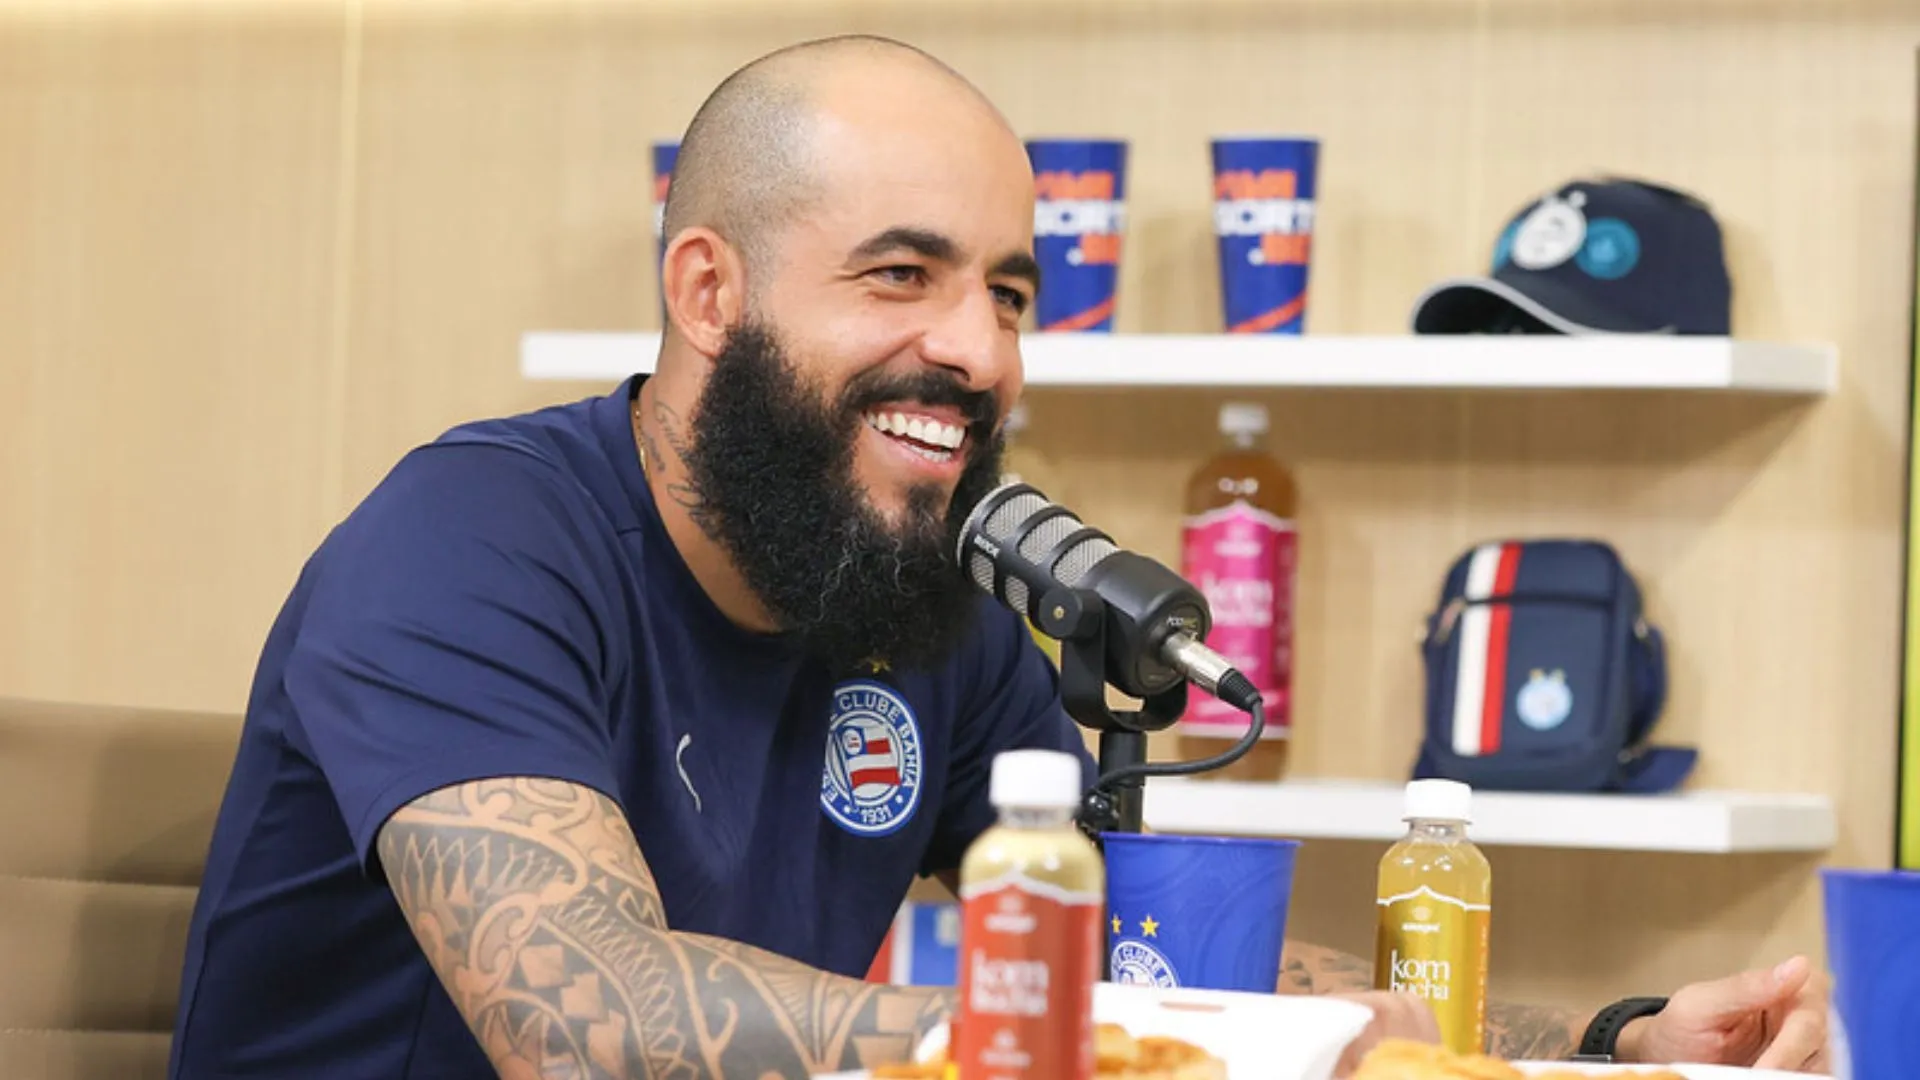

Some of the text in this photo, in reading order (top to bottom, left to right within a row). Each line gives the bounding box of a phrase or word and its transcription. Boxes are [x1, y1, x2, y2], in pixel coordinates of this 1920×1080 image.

[840, 694, 901, 724] CLUBE
[899, 722, 917, 787] BAHIA
[861, 804, 893, 826] 1931
[1391, 949, 1451, 981] kom
